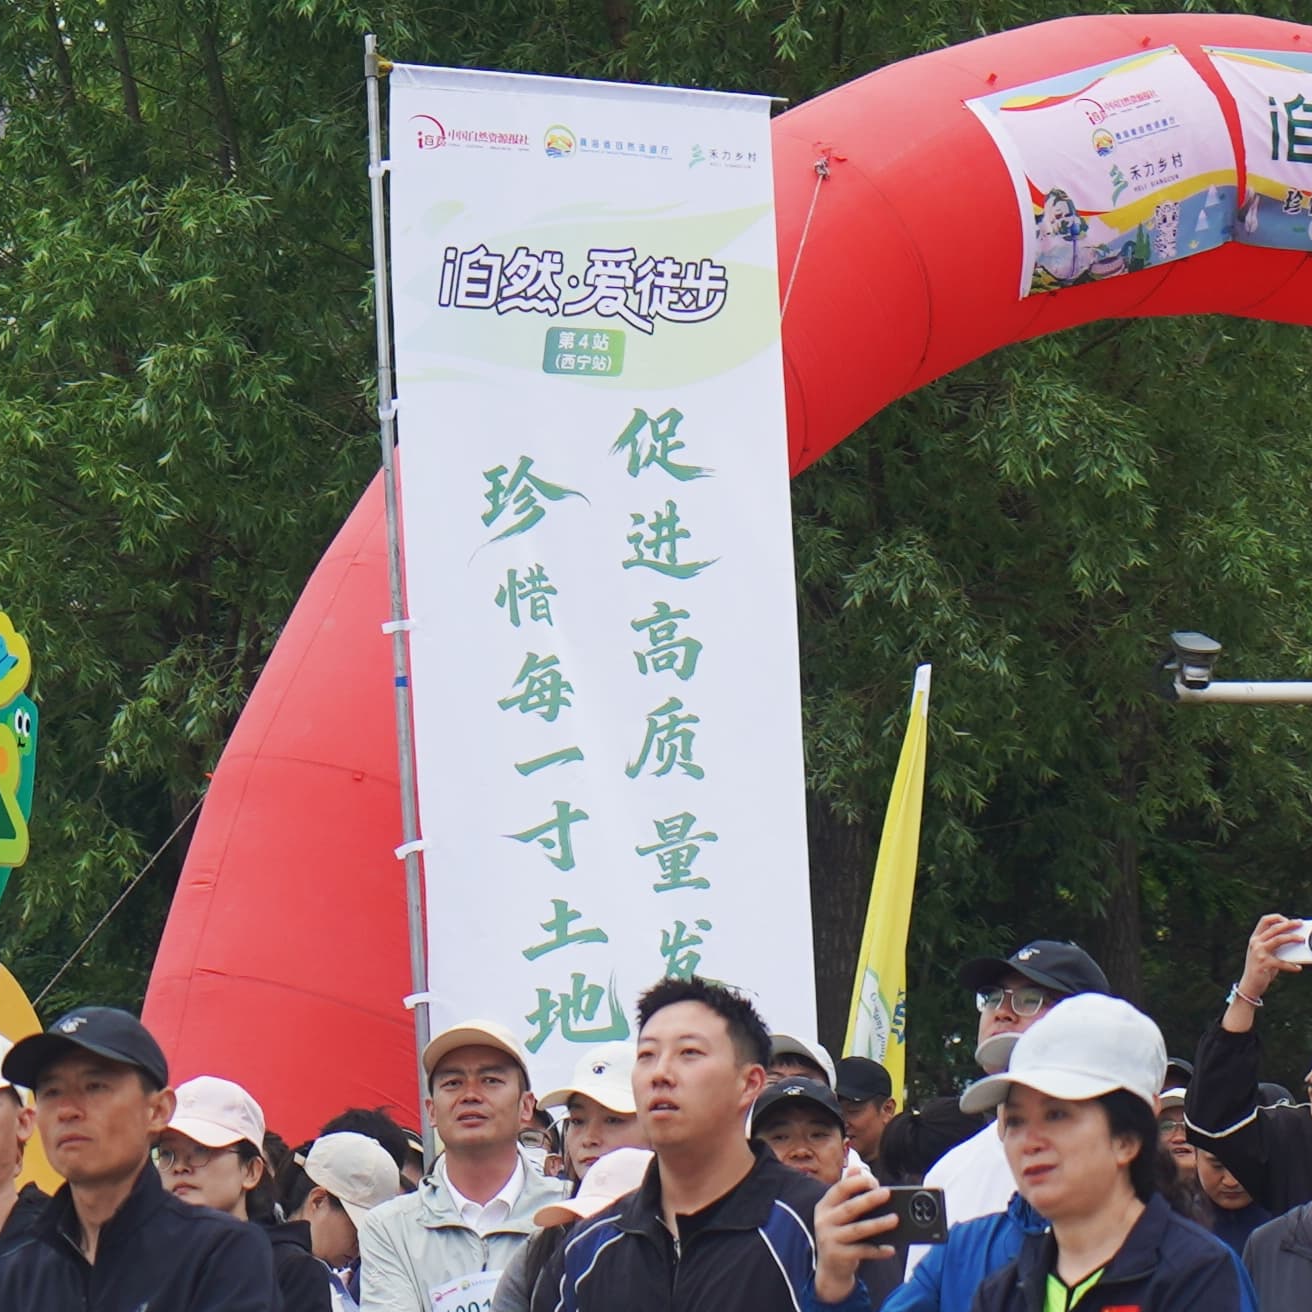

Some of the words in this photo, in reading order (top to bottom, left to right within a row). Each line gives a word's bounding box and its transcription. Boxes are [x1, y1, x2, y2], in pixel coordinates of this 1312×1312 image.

[1130, 152, 1183, 180] 禾力乡村
[557, 332, 609, 351] 第4站
[468, 455, 631, 1053] 珍惜每一寸土地
